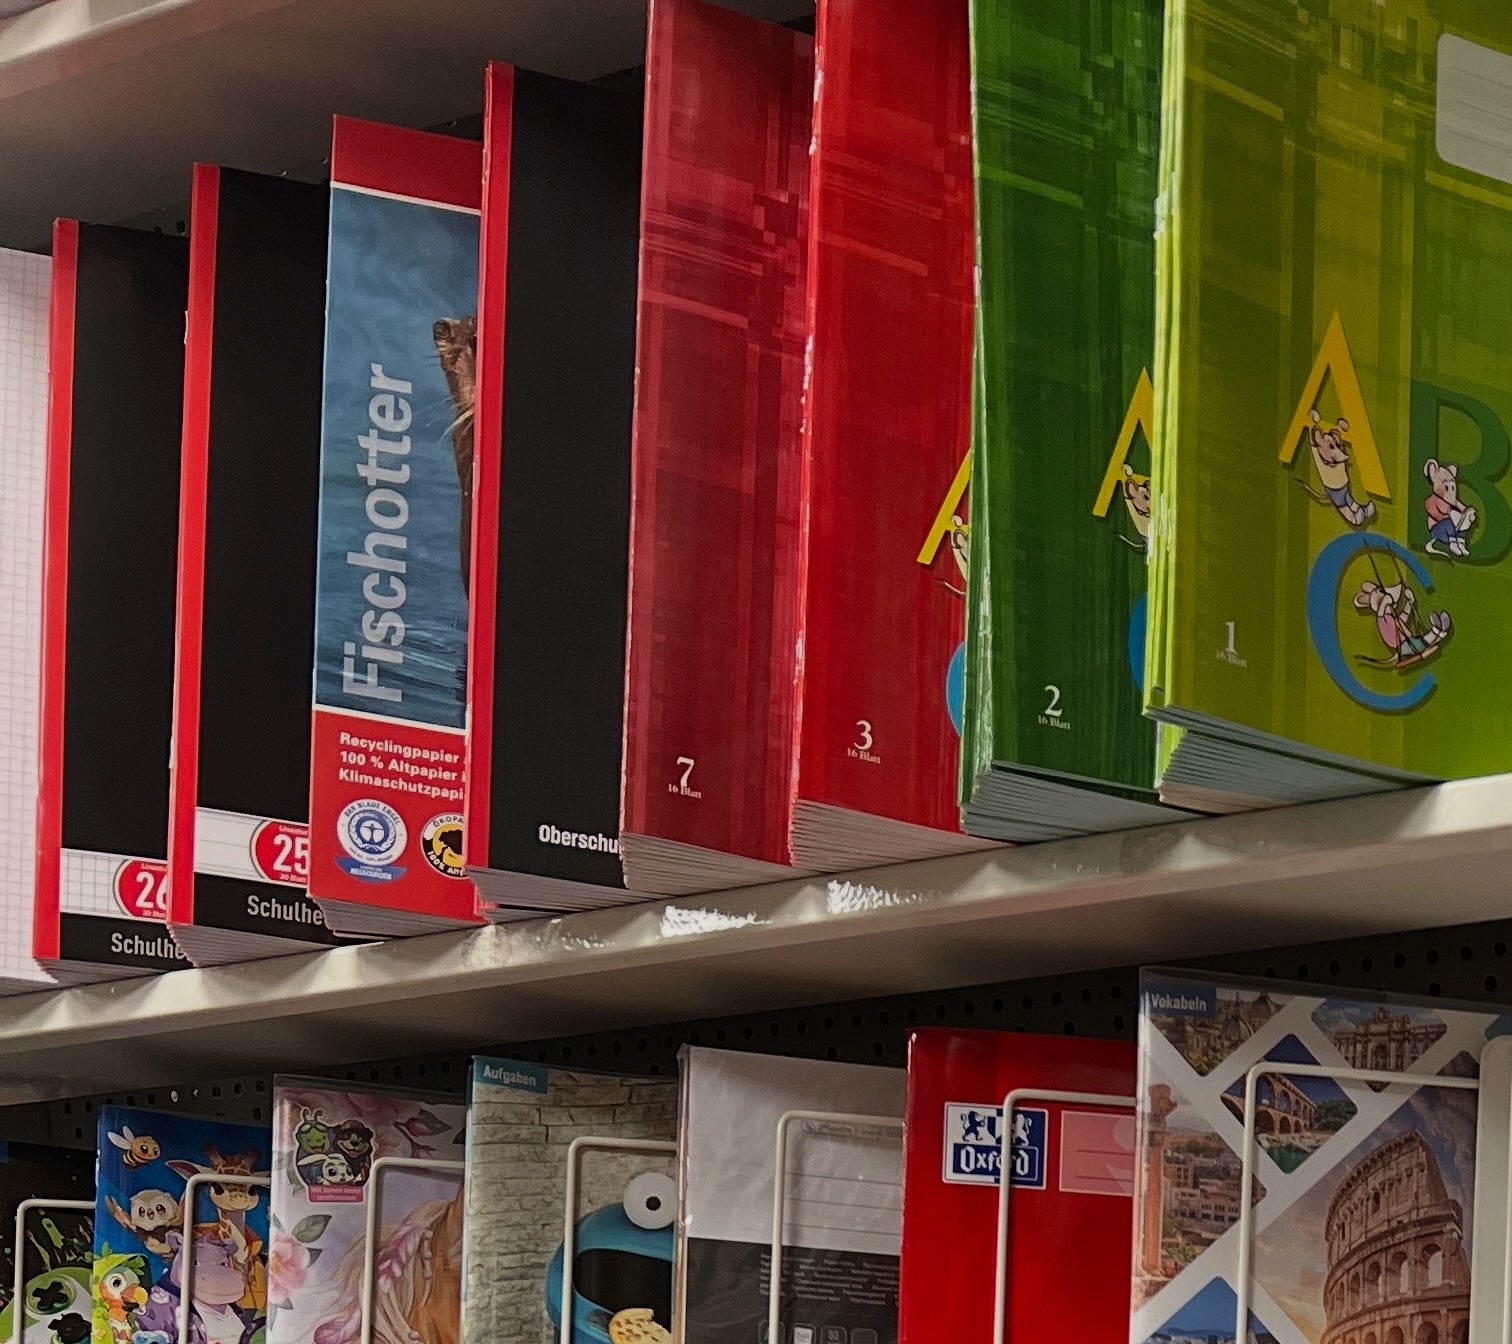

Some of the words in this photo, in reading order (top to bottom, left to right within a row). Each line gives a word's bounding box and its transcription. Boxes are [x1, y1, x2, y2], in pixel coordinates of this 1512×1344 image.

[1279, 309, 1392, 505] A
[343, 363, 412, 703] Fischotter
[1225, 621, 1238, 654] 1
[1306, 532, 1437, 713] C
[1045, 685, 1063, 717] 2
[340, 732, 459, 764] Recyclingpapier
[853, 720, 874, 751] 3
[341, 751, 366, 767] 100
[371, 756, 384, 769] %
[388, 758, 458, 782] Altpapier
[676, 756, 695, 788] 7
[339, 767, 464, 801] Klimaschutzpapi
[273, 833, 310, 876] 25
[247, 894, 323, 926] Schulhe
[1151, 993, 1207, 1012] Vokabeln
[483, 1064, 537, 1087] Aufgaben
